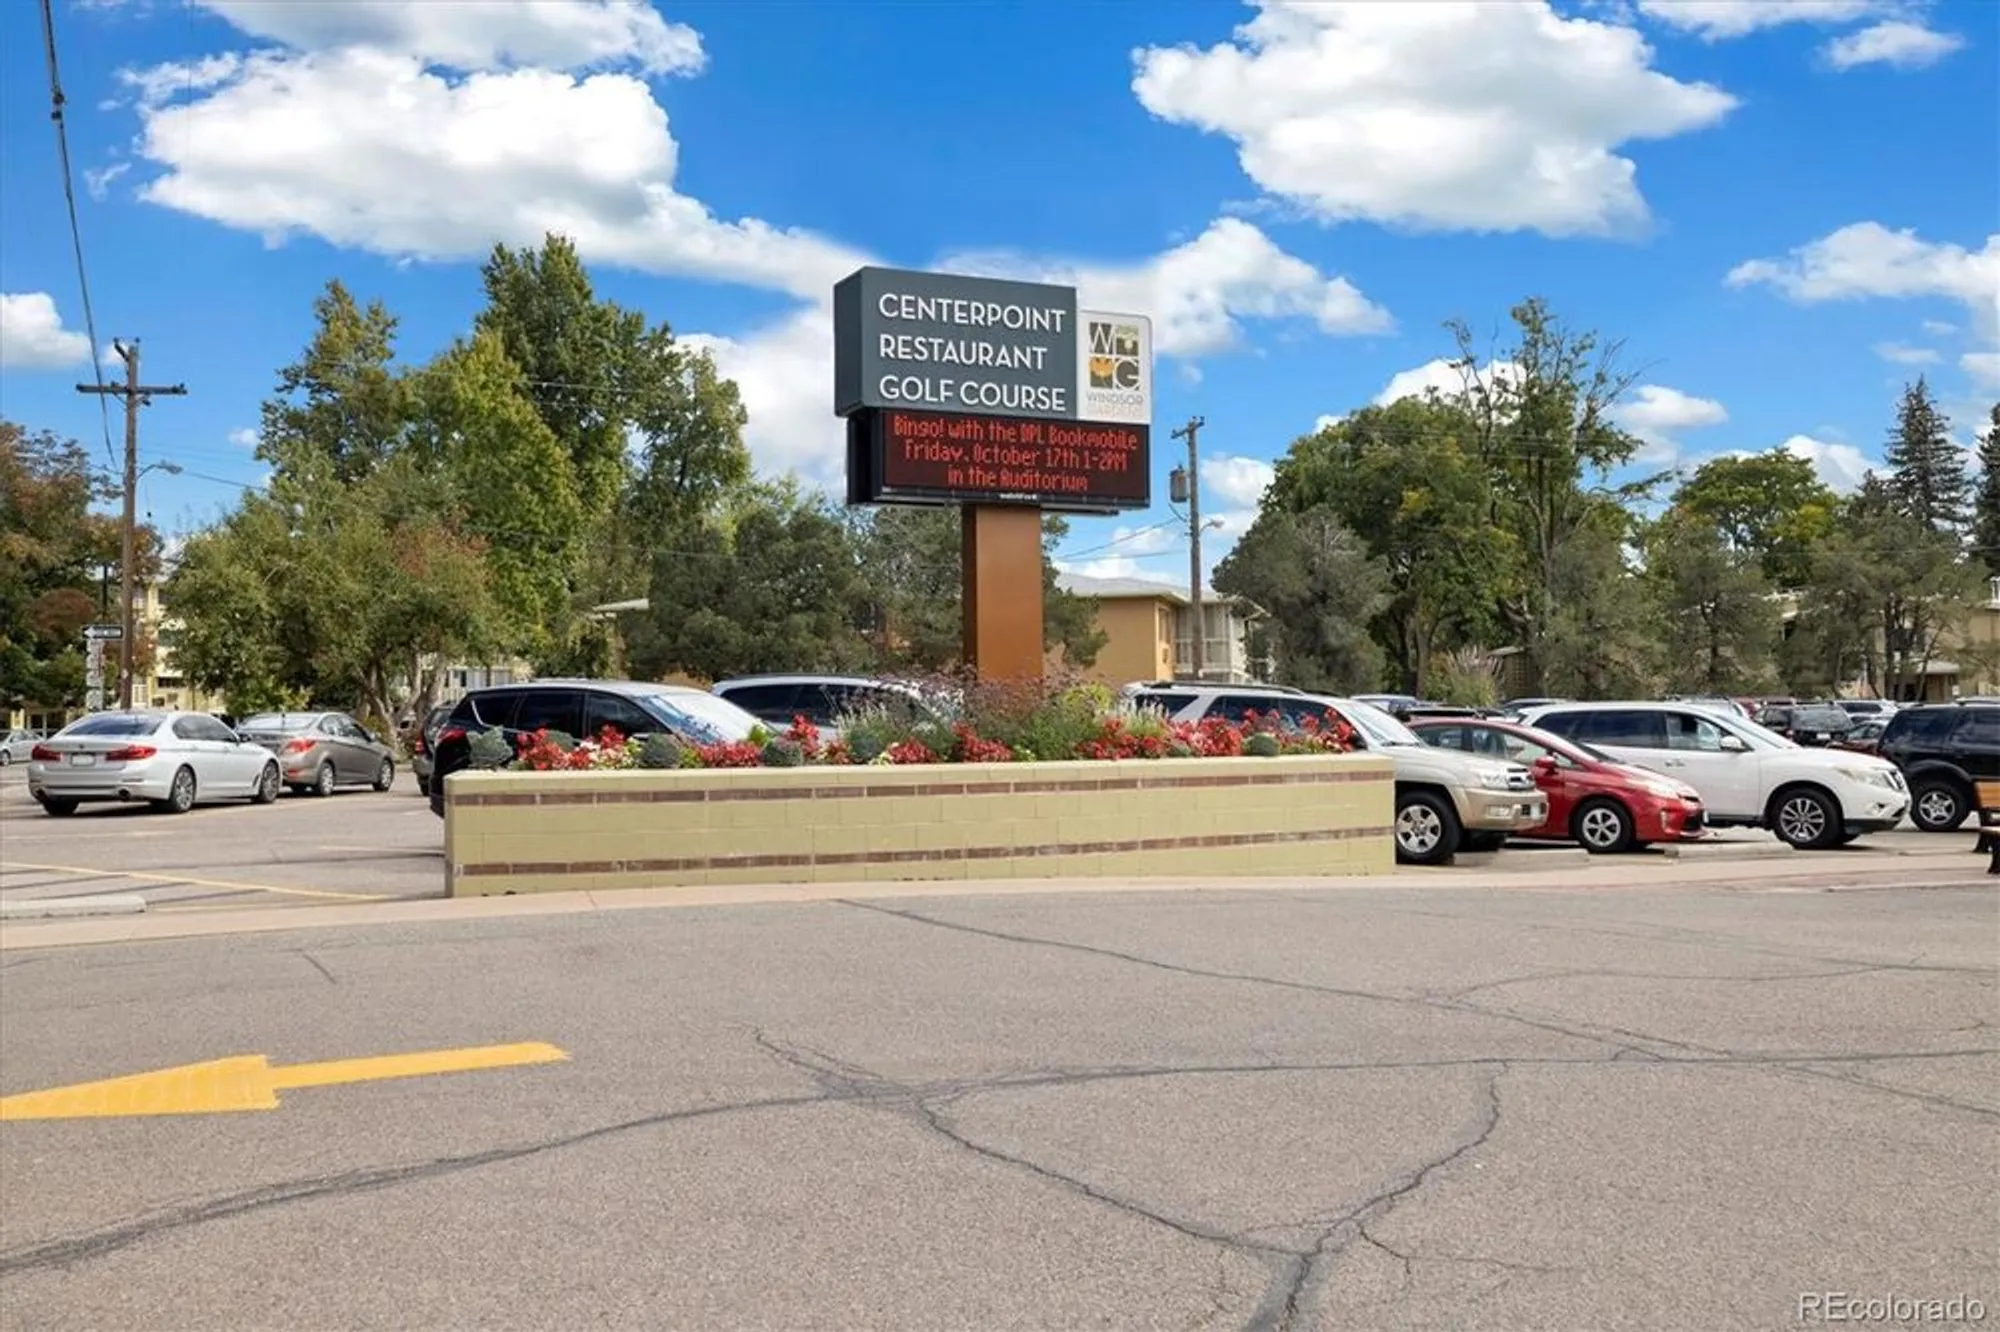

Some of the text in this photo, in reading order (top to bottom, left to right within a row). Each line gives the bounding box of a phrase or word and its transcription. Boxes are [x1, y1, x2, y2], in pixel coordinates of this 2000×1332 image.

[879, 293, 1066, 333] CENTERPOINT
[879, 333, 1048, 370] RESTAURANT
[879, 374, 954, 403] GOLF
[960, 381, 1066, 412] COURSE
[1087, 391, 1144, 405] WINDSOR
[894, 415, 945, 438] Bingo!
[948, 420, 984, 440] with
[988, 421, 1017, 443] the
[1048, 425, 1138, 450] Bookmobile
[974, 442, 1040, 466] October
[1045, 447, 1080, 469] 17th
[947, 464, 1088, 492] in the Auditorium
